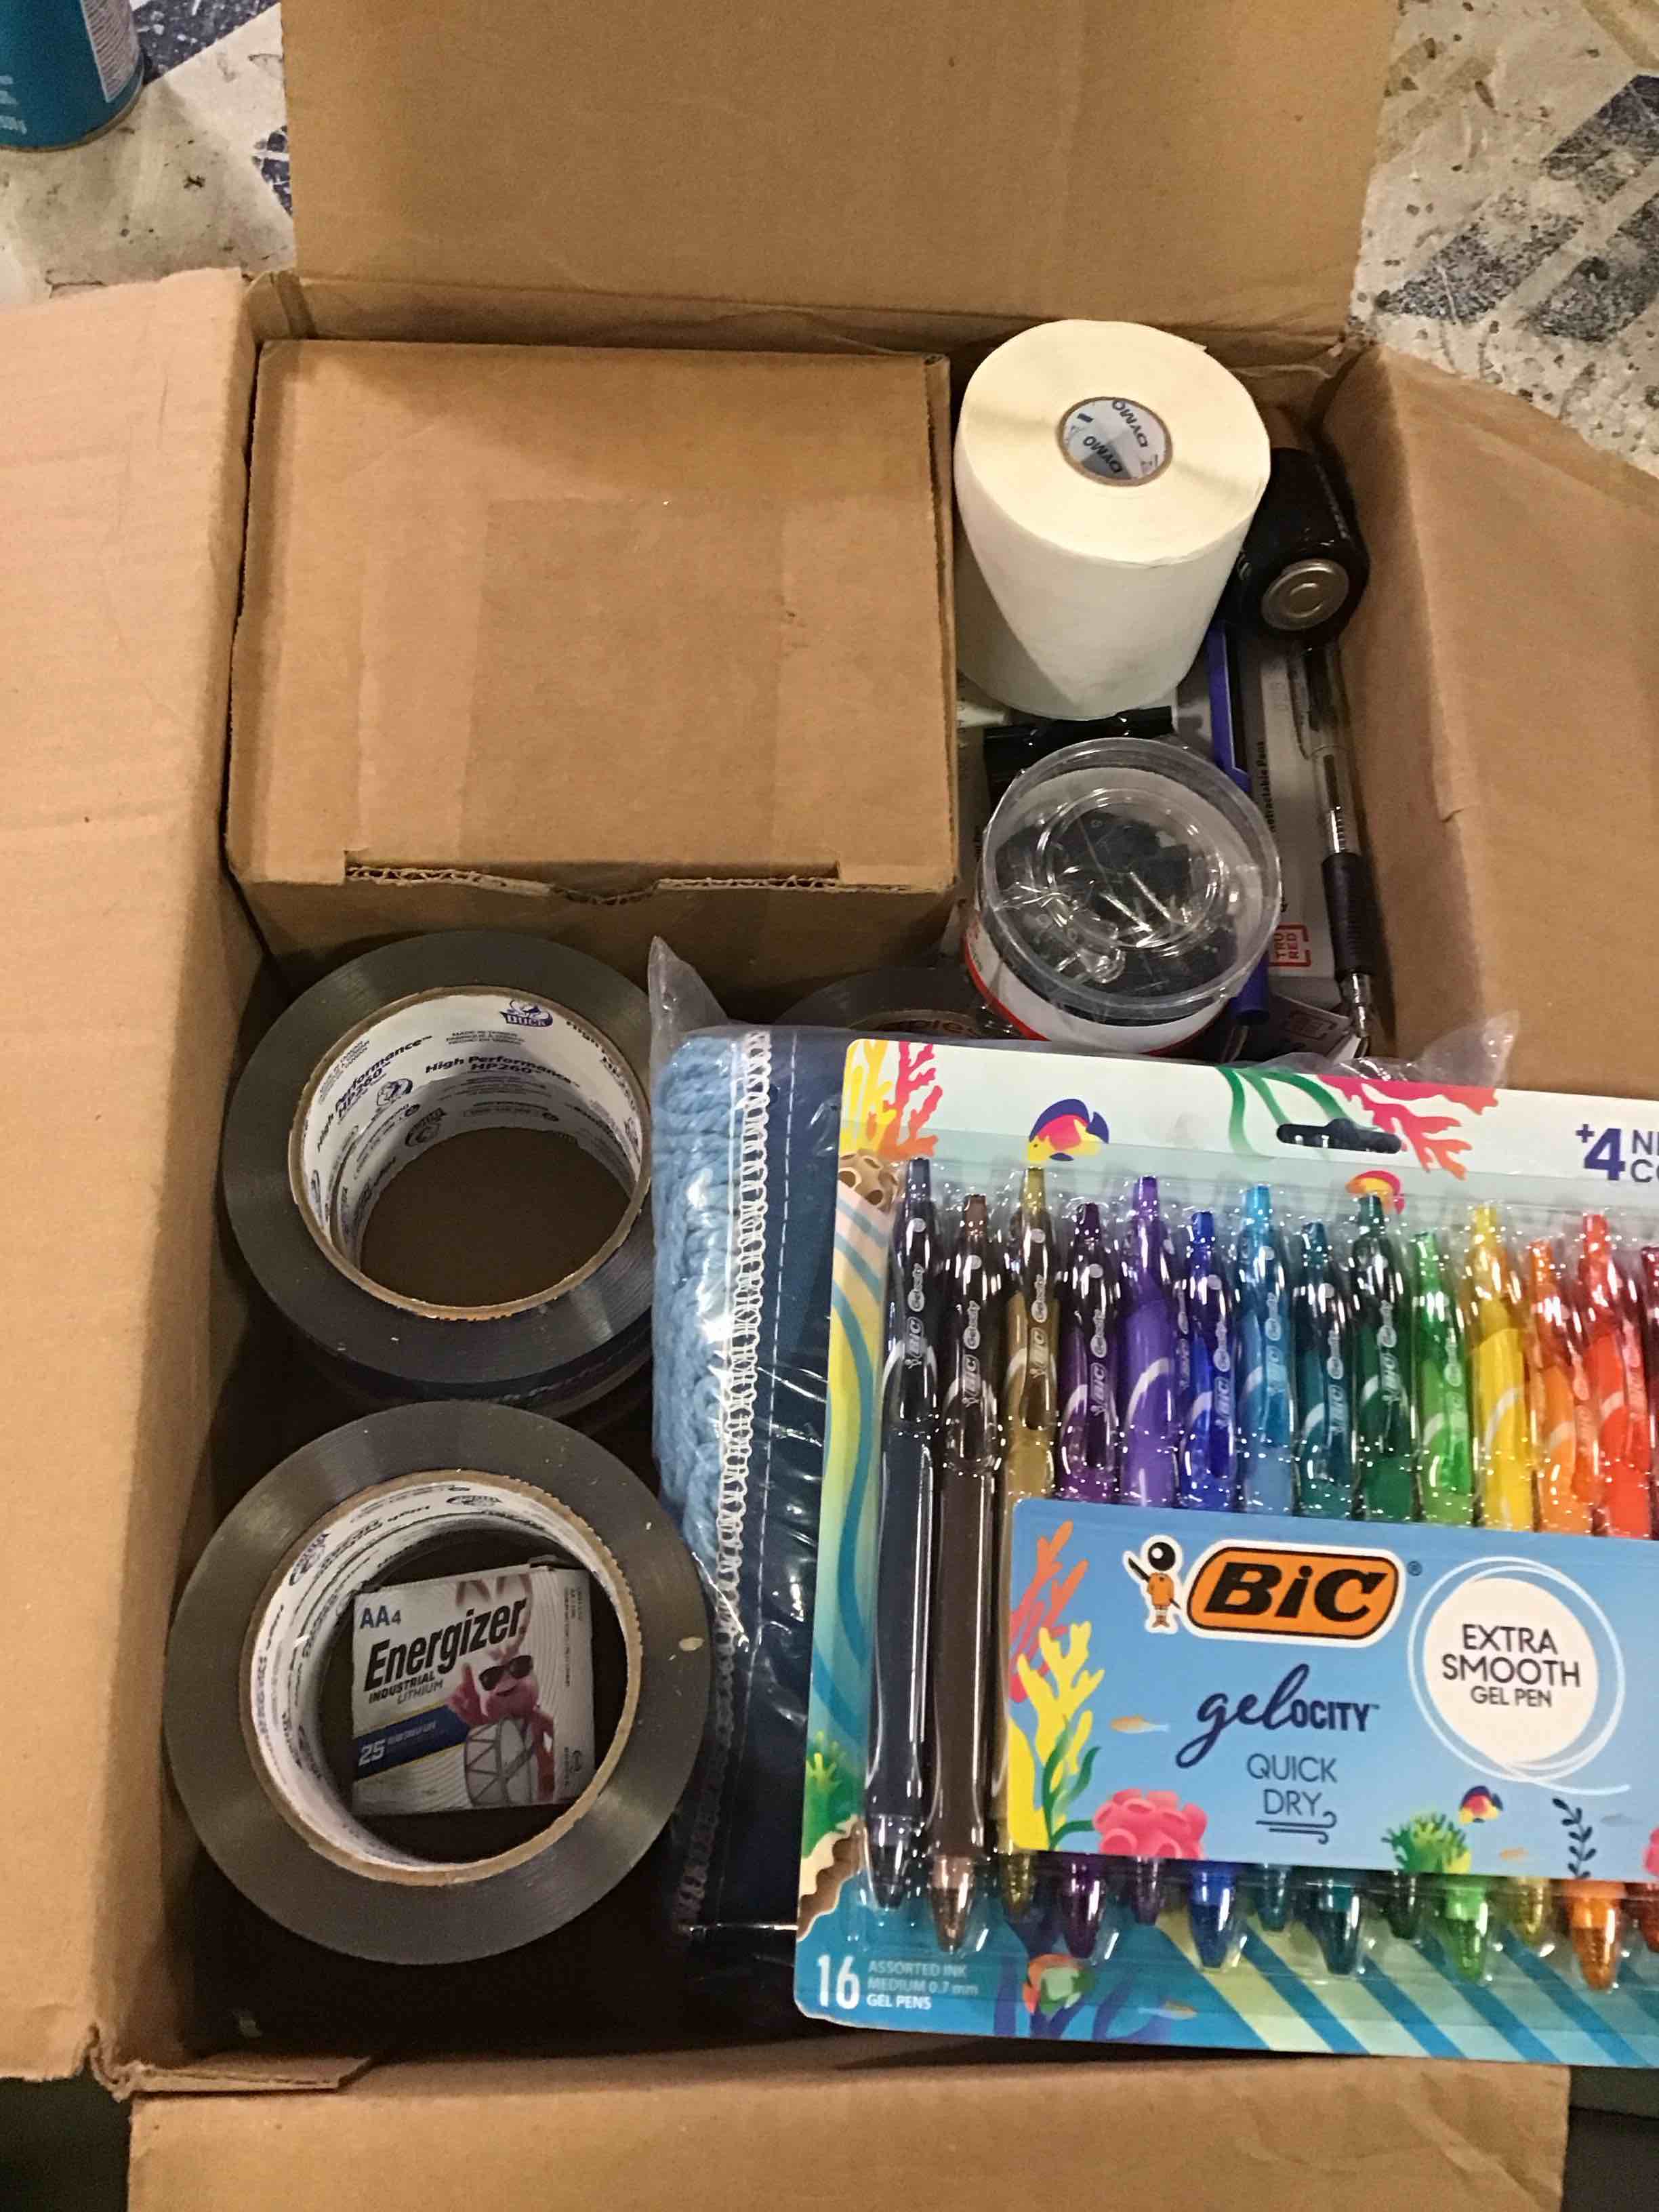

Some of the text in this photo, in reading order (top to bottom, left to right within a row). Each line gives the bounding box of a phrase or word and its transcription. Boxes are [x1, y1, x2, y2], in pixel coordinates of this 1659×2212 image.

[1112, 401, 1148, 448] DYMO
[1083, 436, 1123, 473] DYMO
[425, 1056, 572, 1084] High Performance
[471, 1063, 532, 1074] HP260
[1576, 1124, 1659, 1181] +4 N
[1631, 1159, 1659, 1183] C
[364, 1598, 527, 1692] Energizer
[1462, 1624, 1559, 1654] EXTRA
[1441, 1654, 1581, 1687] SMOOTH
[368, 1671, 436, 1704] INDUSTRIAL
[397, 1681, 443, 1704] LITHIUM
[1471, 1685, 1552, 1708] GEL PEN
[359, 1738, 386, 1765] 25
[1246, 1753, 1337, 1783] QUICK
[1264, 1788, 1322, 1817] DRY
[817, 1953, 861, 2010] 16
[868, 1960, 967, 1977] ASSORTED INK
[867, 1976, 979, 1996] MEDIUM 0.7 mm
[867, 1994, 933, 2010] GEL PENS
